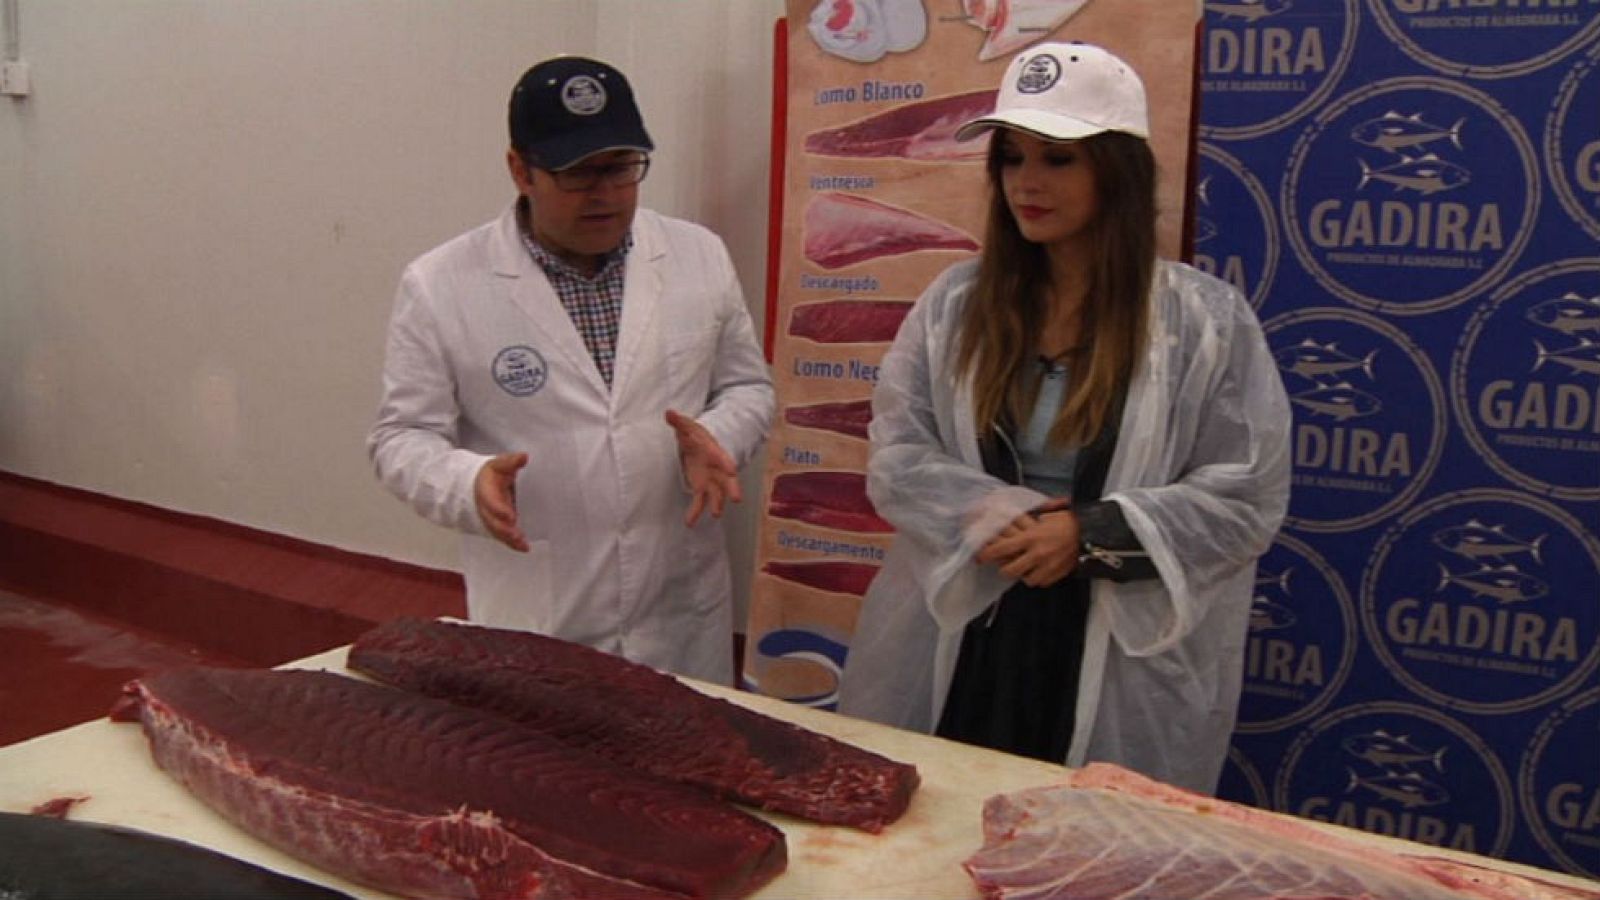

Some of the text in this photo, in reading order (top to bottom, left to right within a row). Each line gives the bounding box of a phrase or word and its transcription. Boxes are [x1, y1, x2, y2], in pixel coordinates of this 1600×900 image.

[1208, 27, 1325, 75] DIRA
[862, 80, 925, 102] Blanco
[1309, 199, 1503, 251] GADIRA
[800, 273, 880, 293] Descargado
[794, 357, 881, 387] Lomo Neg
[1479, 379, 1600, 434] GAD
[782, 446, 821, 465] Plato
[1295, 424, 1411, 476] DIRA
[1386, 598, 1578, 662] GADIRA
[1248, 638, 1322, 686] IRA
